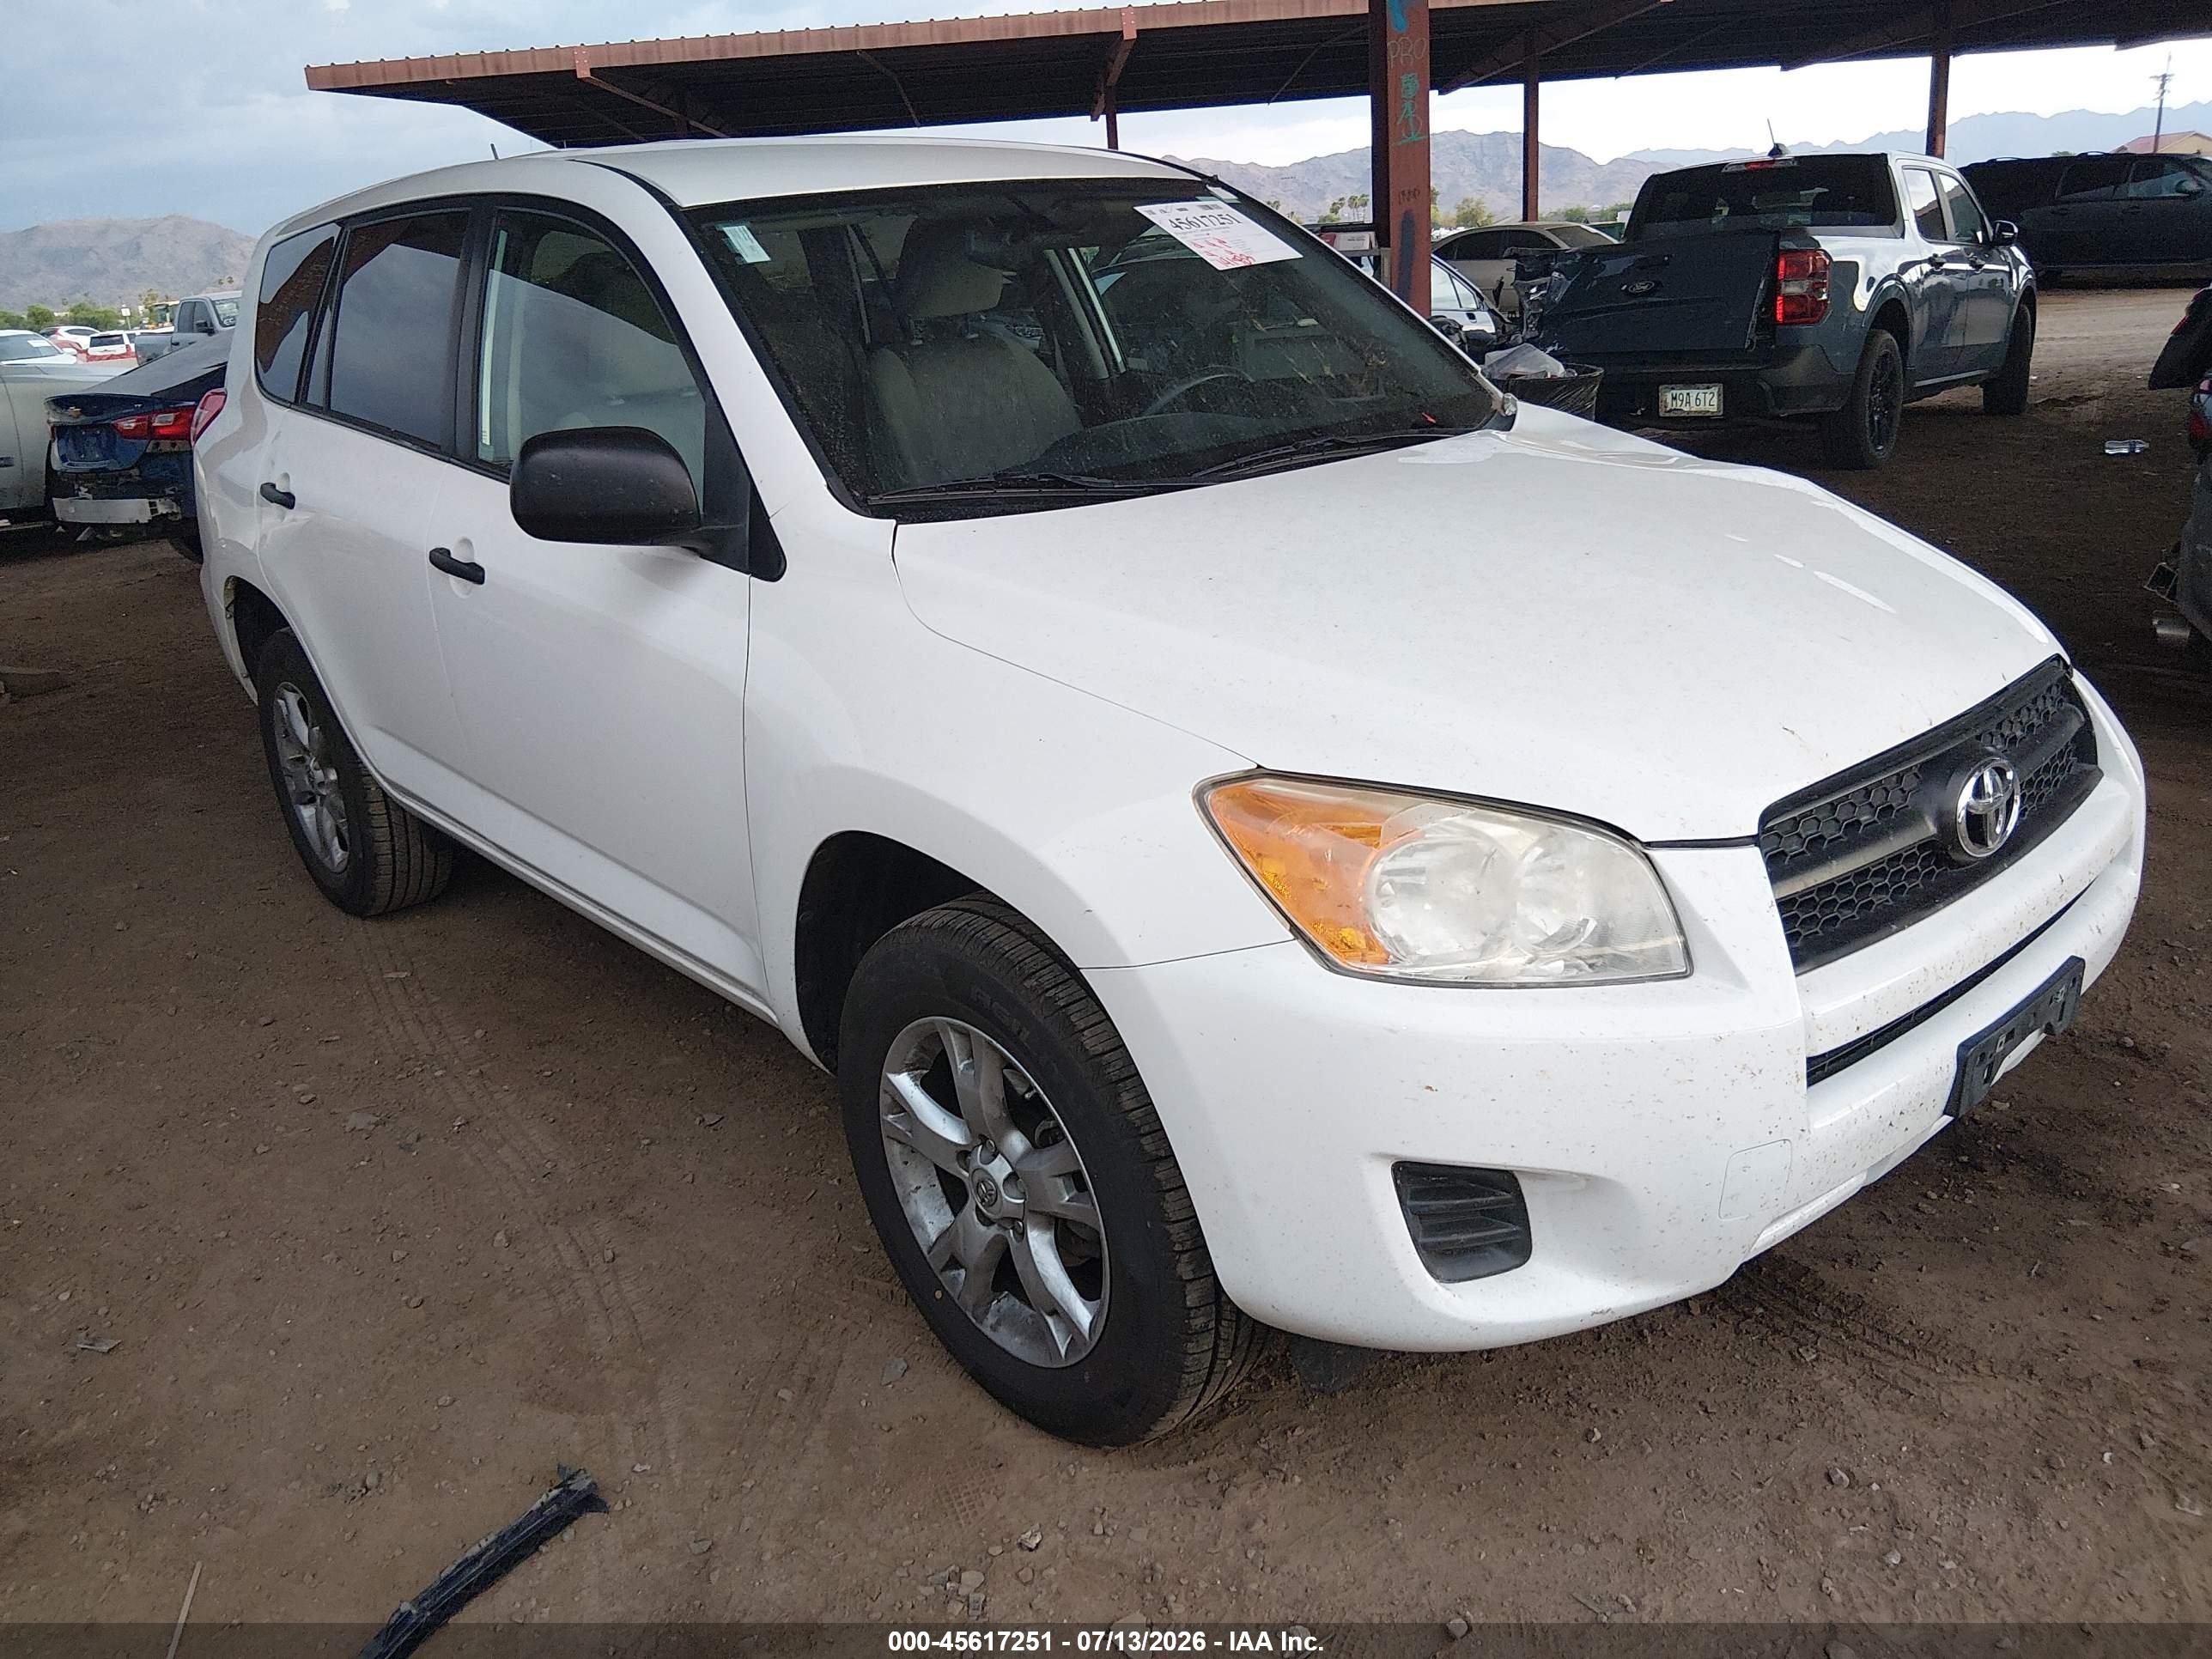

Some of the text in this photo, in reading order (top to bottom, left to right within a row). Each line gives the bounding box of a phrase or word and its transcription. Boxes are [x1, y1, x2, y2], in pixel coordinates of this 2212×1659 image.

[1387, 36, 1426, 69] PRO
[1169, 212, 1243, 231] 45617251
[1671, 392, 1716, 408] M9A 6T2
